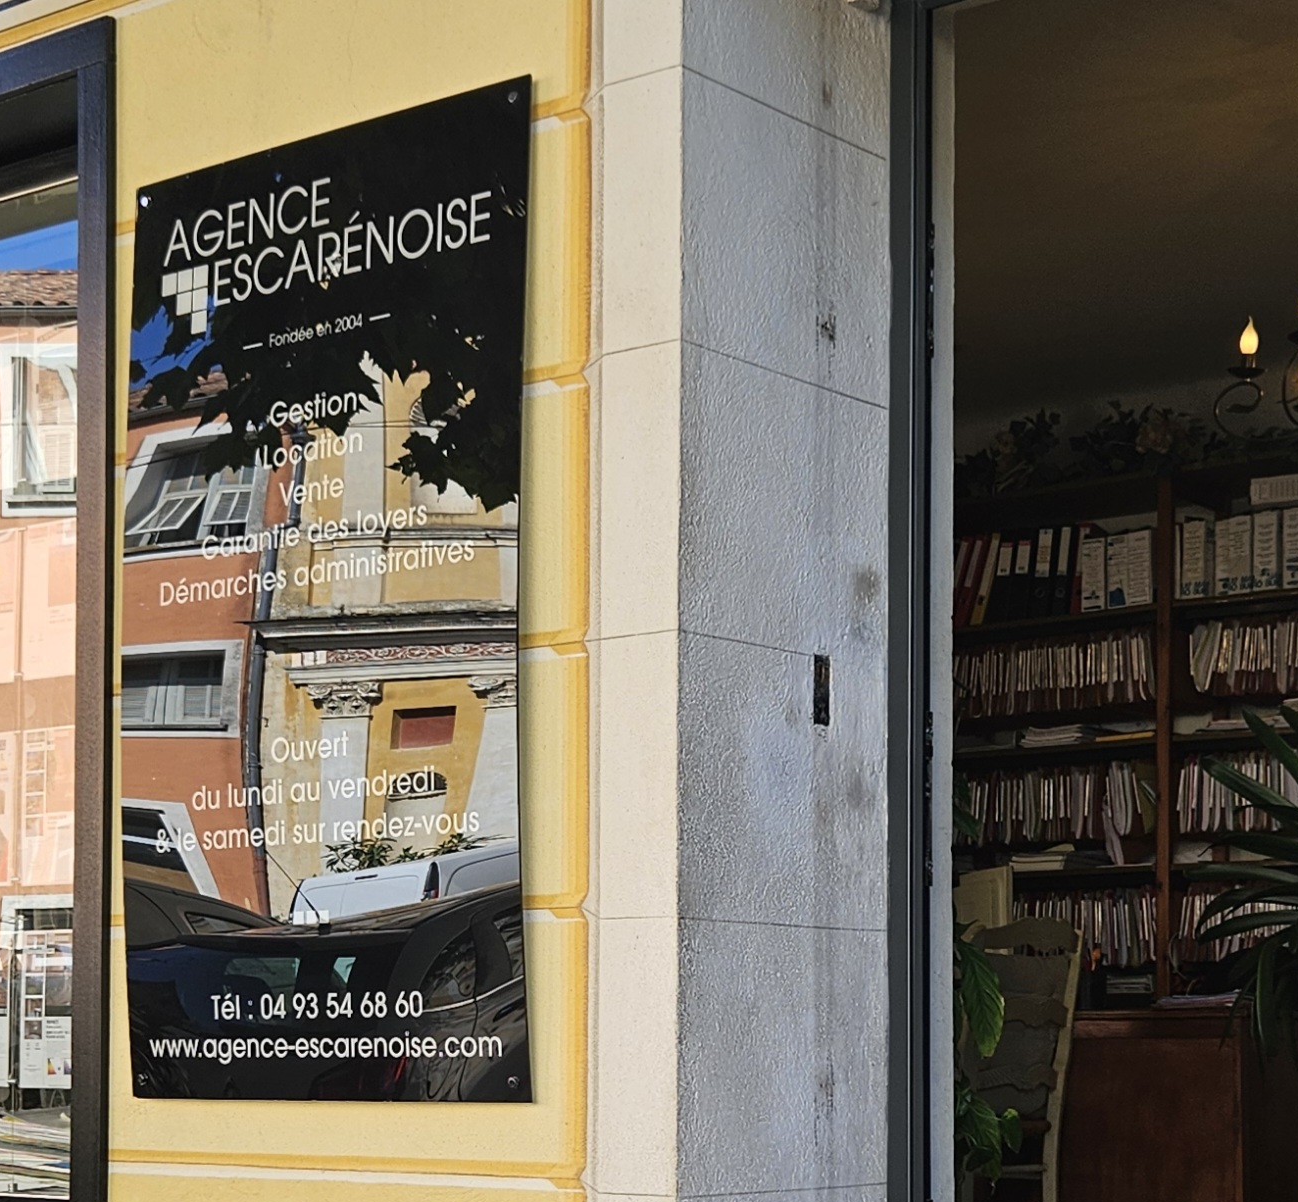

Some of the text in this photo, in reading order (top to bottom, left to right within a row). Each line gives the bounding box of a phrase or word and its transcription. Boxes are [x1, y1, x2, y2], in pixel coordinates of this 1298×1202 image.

[163, 177, 331, 267] AGENCE
[213, 191, 492, 307] ESCARÉNOISE
[269, 313, 363, 348] Fondée en 2004
[269, 390, 358, 428] Gestion
[262, 432, 363, 470] Location
[279, 474, 345, 507] Vente
[202, 503, 428, 560] Garantie des loyers
[159, 538, 476, 607] Démarches administratives
[270, 730, 349, 763] Ouvert
[192, 765, 436, 811] du lundi au vendredi
[203, 819, 285, 850] samedi
[293, 823, 325, 844] sur
[333, 809, 479, 842] rendez-vous
[210, 993, 241, 1020] Tél
[260, 993, 286, 1020] 04
[293, 993, 319, 1020] 93
[326, 992, 353, 1019] 54
[360, 991, 387, 1018] 68
[397, 991, 424, 1018] 60
[149, 1030, 503, 1064] www.agence-escarenoise.com
